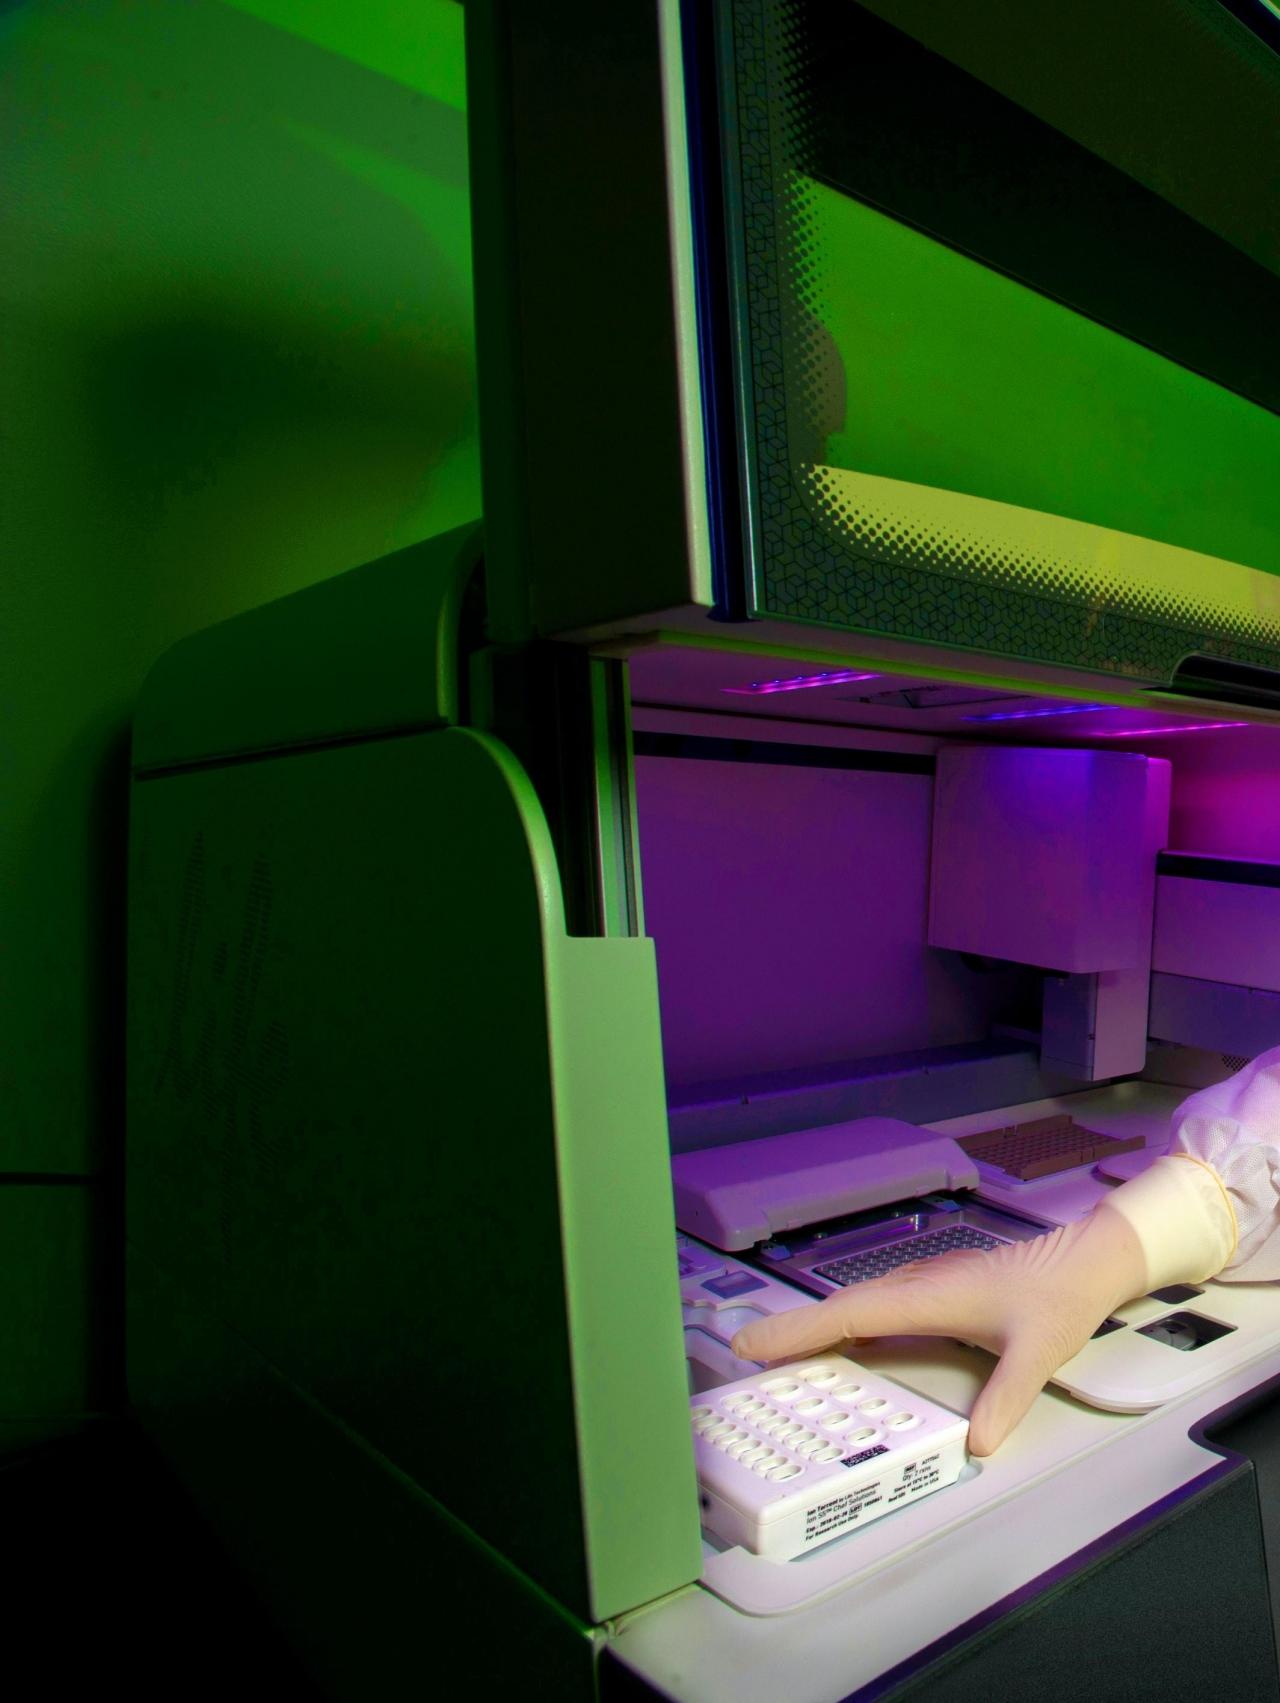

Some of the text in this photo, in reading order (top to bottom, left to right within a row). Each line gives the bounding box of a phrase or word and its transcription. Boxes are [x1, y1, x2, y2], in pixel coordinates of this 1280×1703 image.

[806, 1515, 817, 1525] Ion
[833, 1501, 848, 1512] Chef
[848, 1490, 877, 1506] Solutions
[807, 1508, 817, 1516] Ion
[817, 1498, 839, 1512] Torrent
[815, 1522, 838, 1537] Research
